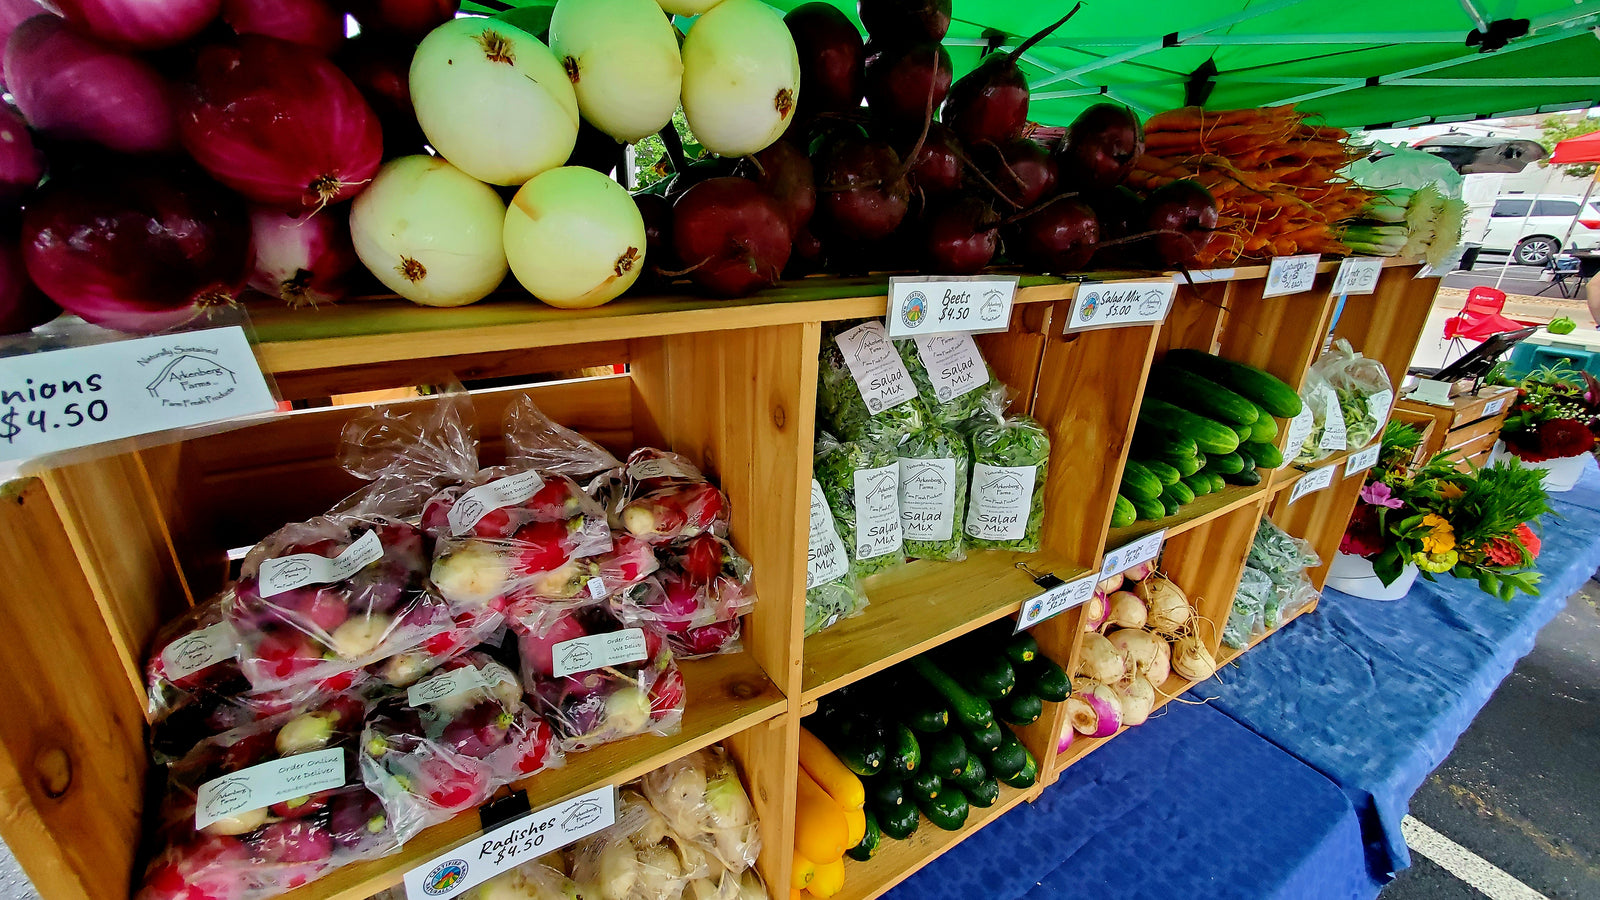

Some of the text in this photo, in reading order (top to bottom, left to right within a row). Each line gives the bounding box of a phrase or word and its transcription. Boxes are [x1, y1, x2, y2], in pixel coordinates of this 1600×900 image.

[942, 288, 970, 307] Beets
[1100, 291, 1124, 305] Salad
[1124, 290, 1141, 303] Mix
[939, 307, 970, 323] $4.50
[1106, 305, 1131, 318] $5.00
[137, 345, 219, 367] Naturally Sustained
[169, 367, 223, 383] Arkenberg
[941, 357, 974, 380] Salad
[180, 381, 212, 391] Farms
[871, 368, 903, 390] Salad
[951, 372, 973, 387] Mix
[0, 374, 102, 405] nions
[880, 384, 904, 399] Mix
[0, 399, 108, 444] $4.50
[900, 511, 942, 522] Salad
[977, 514, 1018, 524] Salad
[867, 518, 899, 537] Salad
[908, 522, 934, 532] Mix
[984, 524, 1009, 532] Mix
[874, 535, 895, 547] Mix
[808, 539, 836, 561] Salad
[815, 556, 836, 573] Mix
[1047, 585, 1075, 606] Zucchini
[1048, 596, 1067, 611] $2.25
[607, 637, 624, 645] Order
[278, 756, 338, 774] Order Online
[286, 768, 335, 783] We Deliver
[479, 817, 556, 859] Radishes
[494, 834, 545, 865] $4.50
